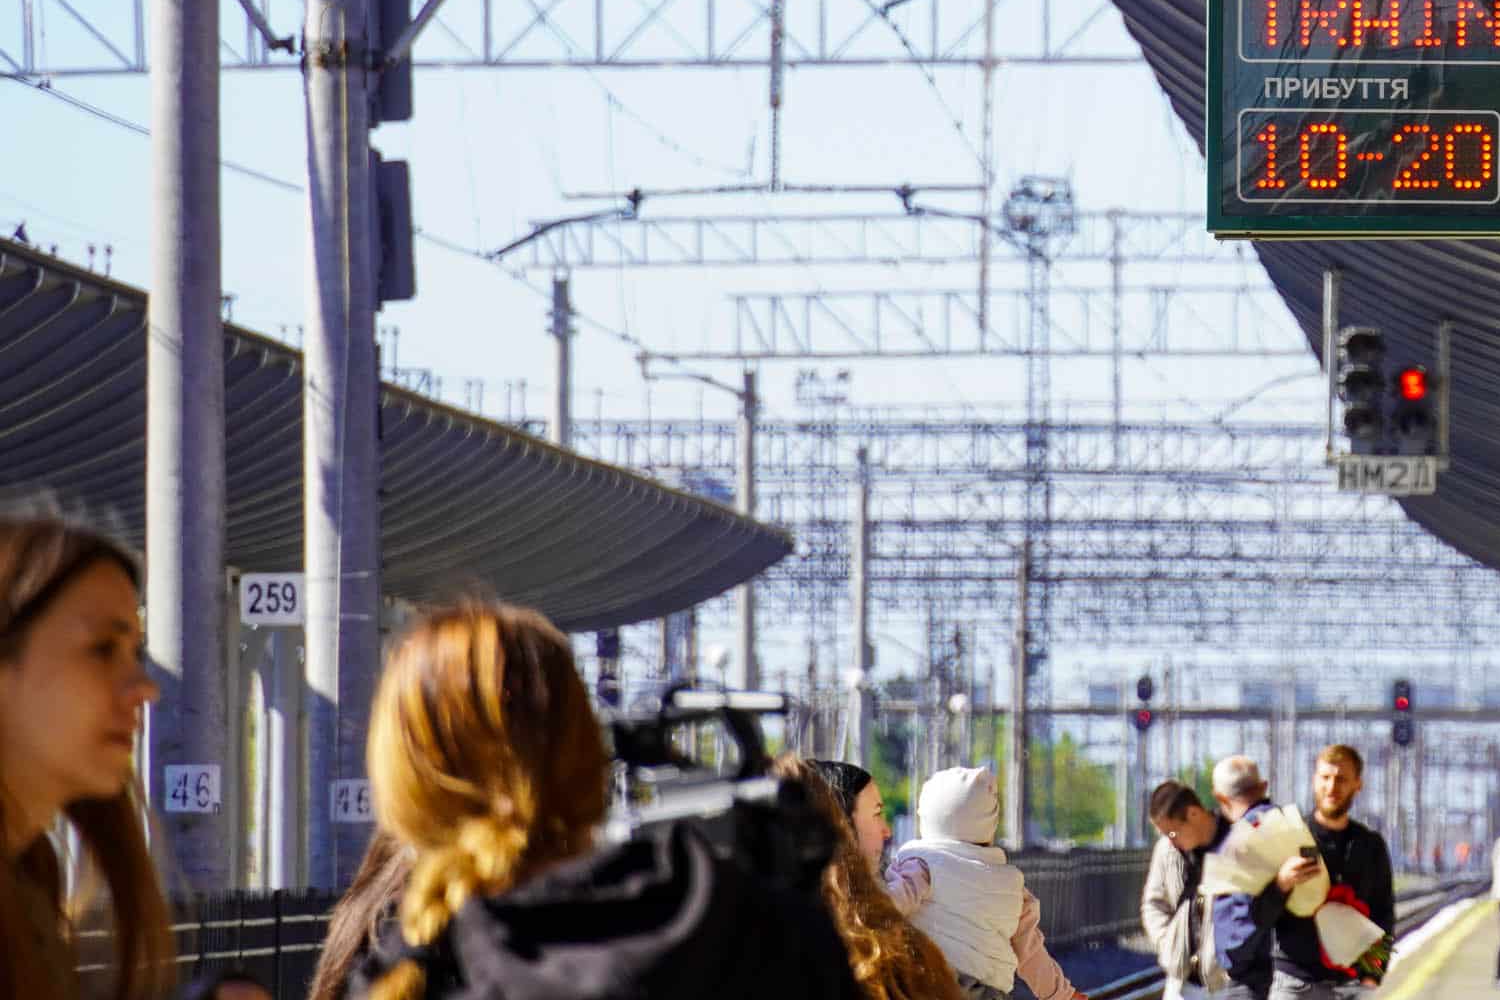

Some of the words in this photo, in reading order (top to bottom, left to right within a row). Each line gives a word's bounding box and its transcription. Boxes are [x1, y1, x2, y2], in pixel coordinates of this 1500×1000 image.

[1263, 75, 1410, 101] ПРИБУТТЯ
[1254, 122, 1493, 190] 10-20
[248, 581, 297, 614] 259
[171, 771, 211, 809] 46
